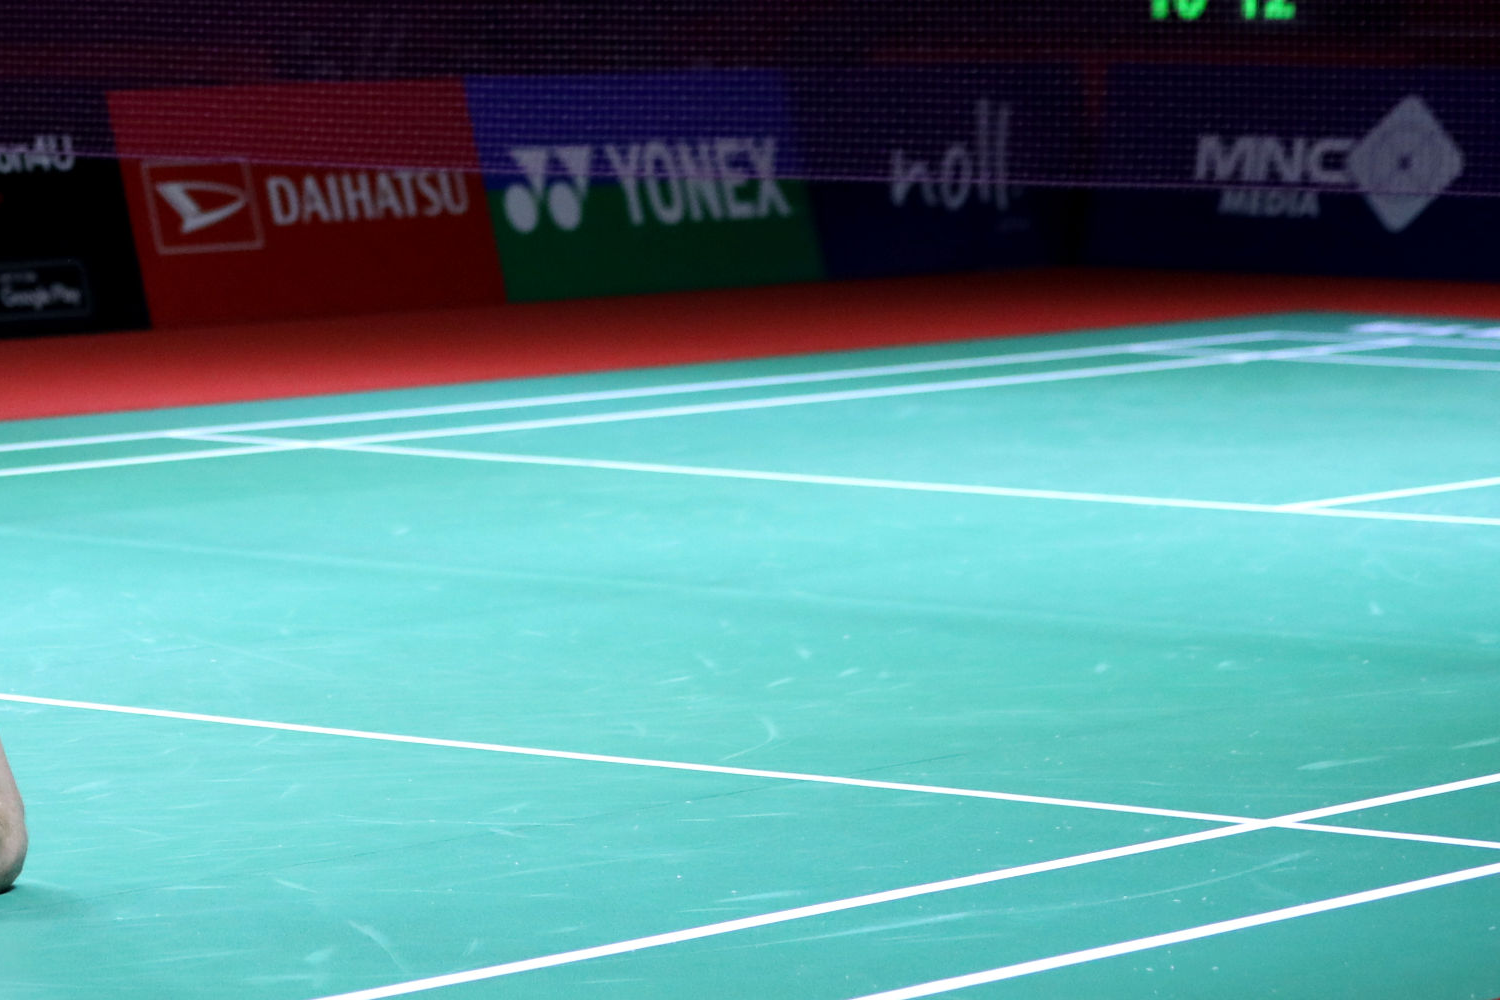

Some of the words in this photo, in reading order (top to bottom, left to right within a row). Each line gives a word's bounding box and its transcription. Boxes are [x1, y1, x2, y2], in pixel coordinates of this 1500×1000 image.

[603, 134, 794, 226] YONEX
[1194, 133, 1354, 184] MNC
[264, 160, 471, 227] DAIHATSU
